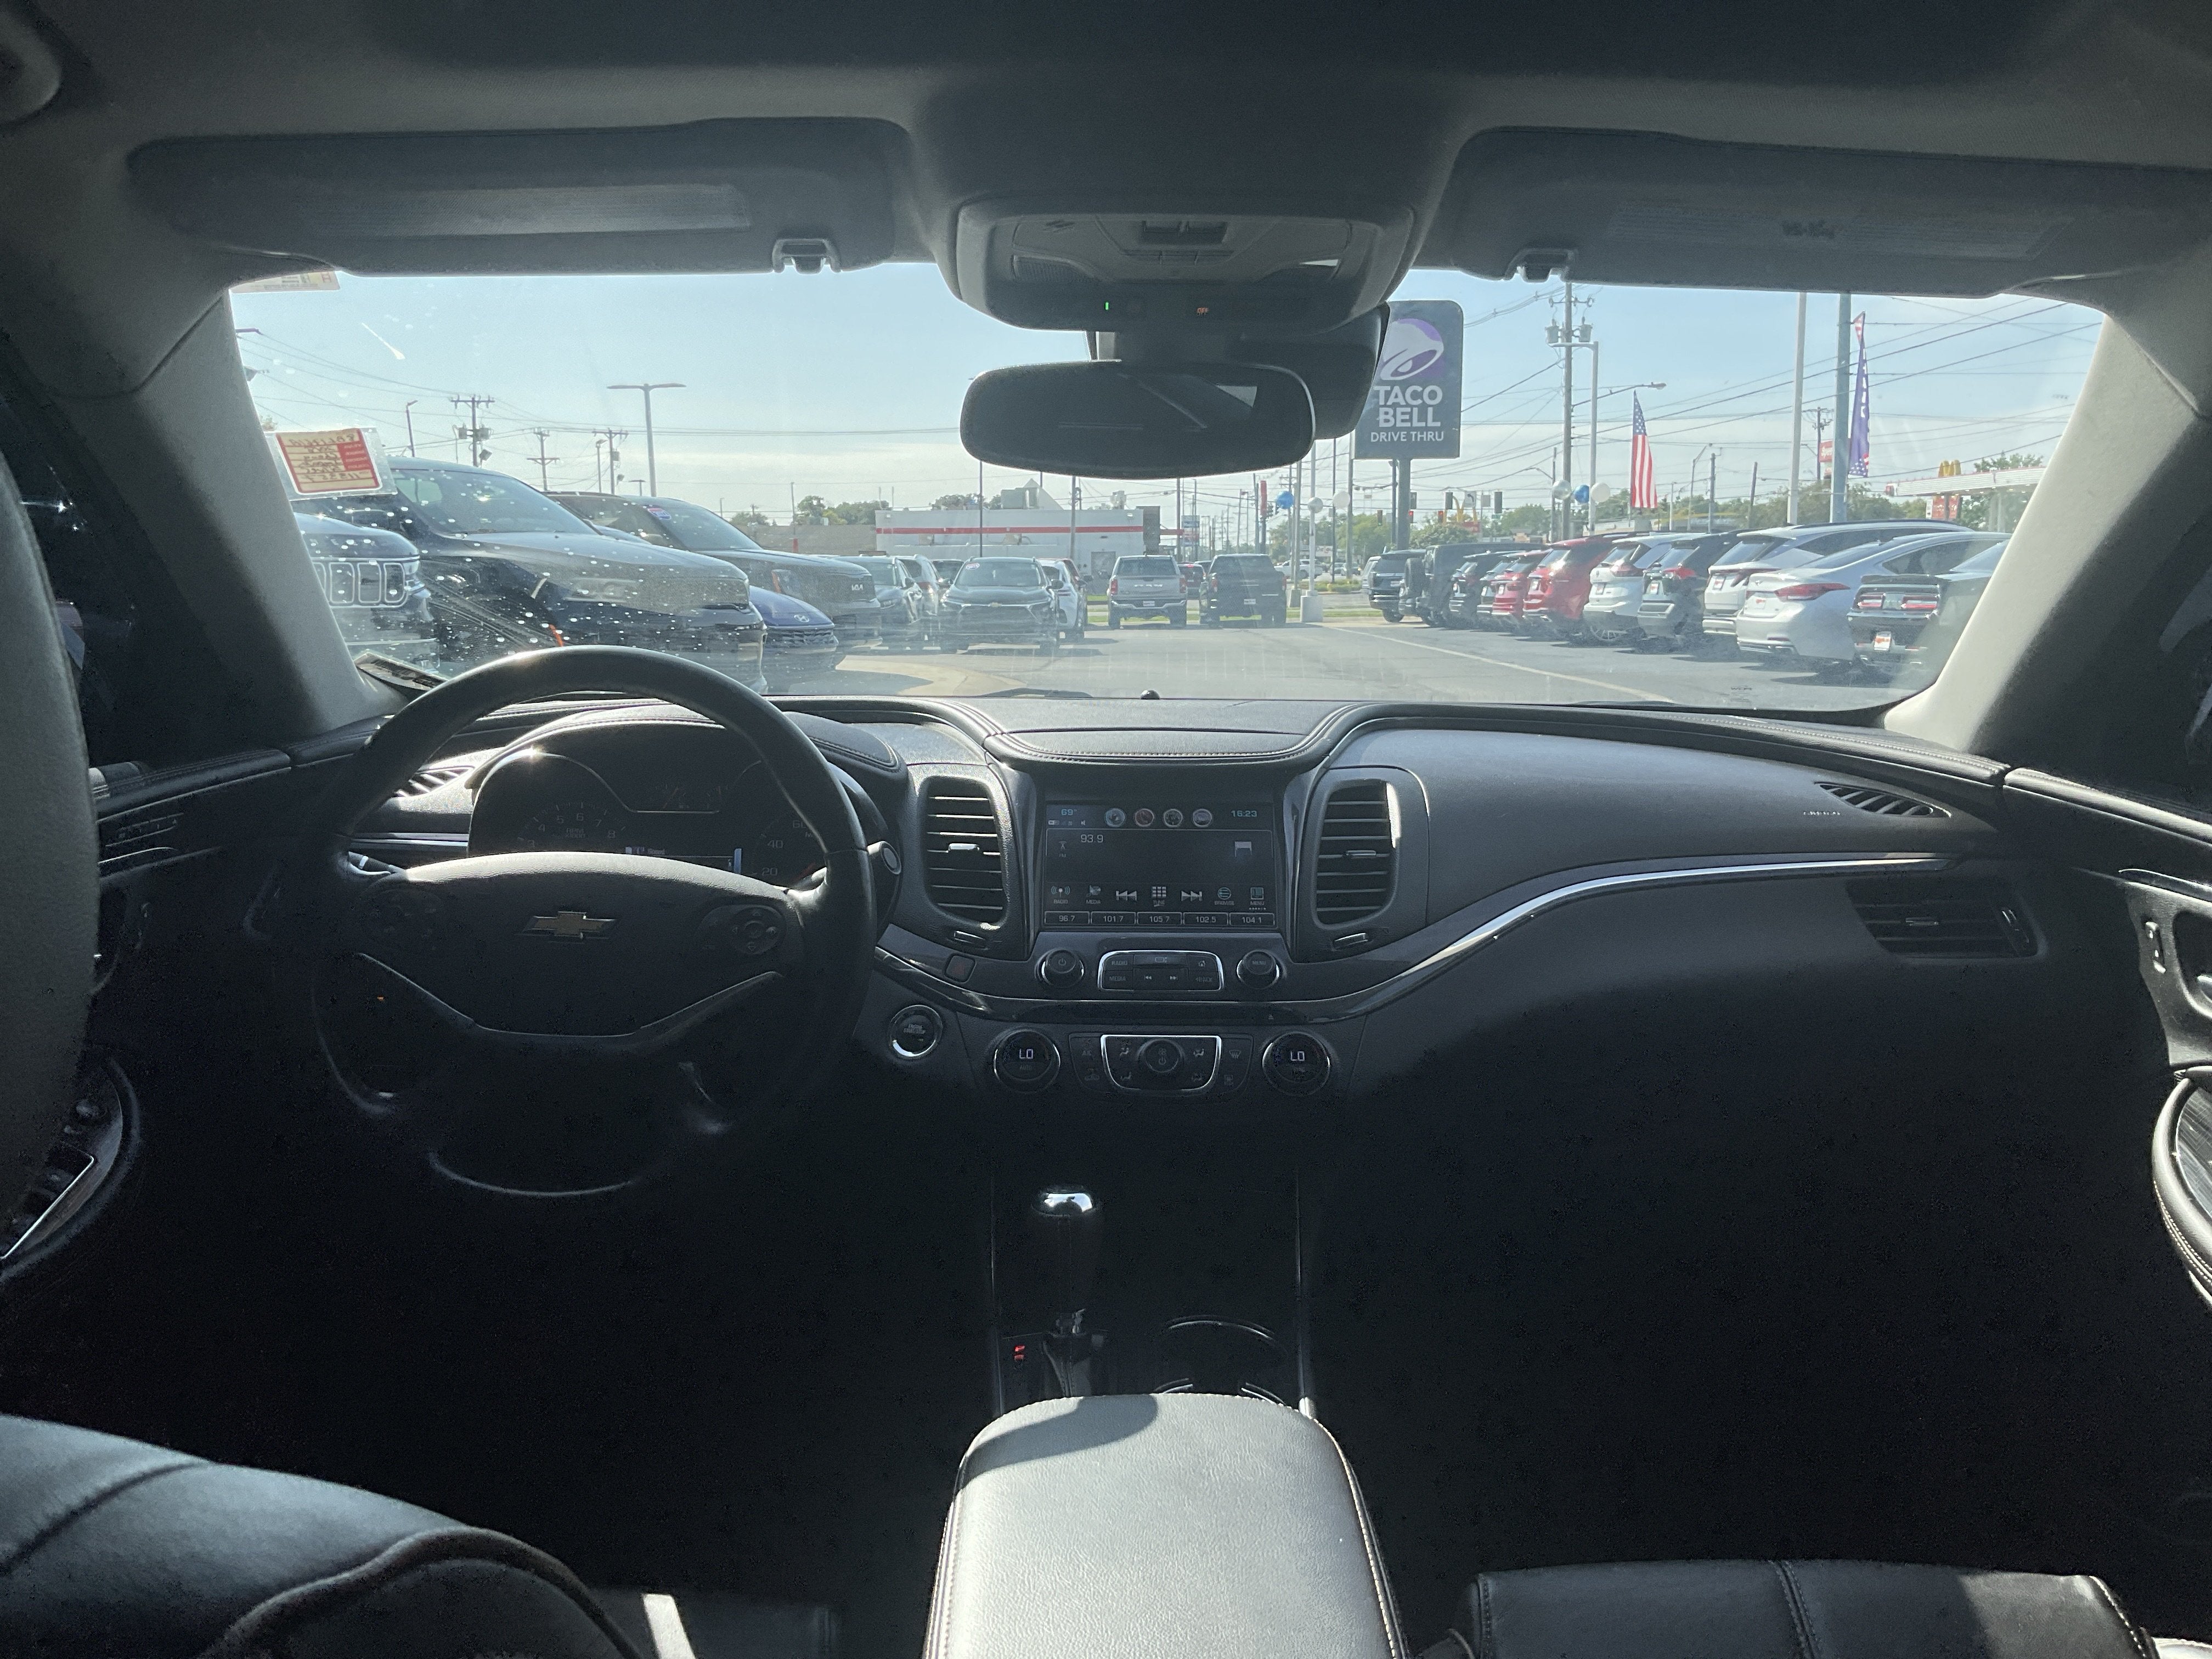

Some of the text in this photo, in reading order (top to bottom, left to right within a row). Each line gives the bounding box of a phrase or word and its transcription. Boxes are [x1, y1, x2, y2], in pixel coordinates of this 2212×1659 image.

[1373, 385, 1443, 405] TACO
[1379, 407, 1441, 427] BELL
[1370, 431, 1444, 442] DRIVE THRU
[557, 815, 564, 823] 5
[577, 812, 584, 821] 6
[595, 819, 602, 827] 7
[538, 824, 545, 832] 4
[607, 830, 616, 839] 8
[1080, 834, 1104, 843] 93.9
[767, 839, 783, 849] 40
[761, 867, 778, 876] 20
